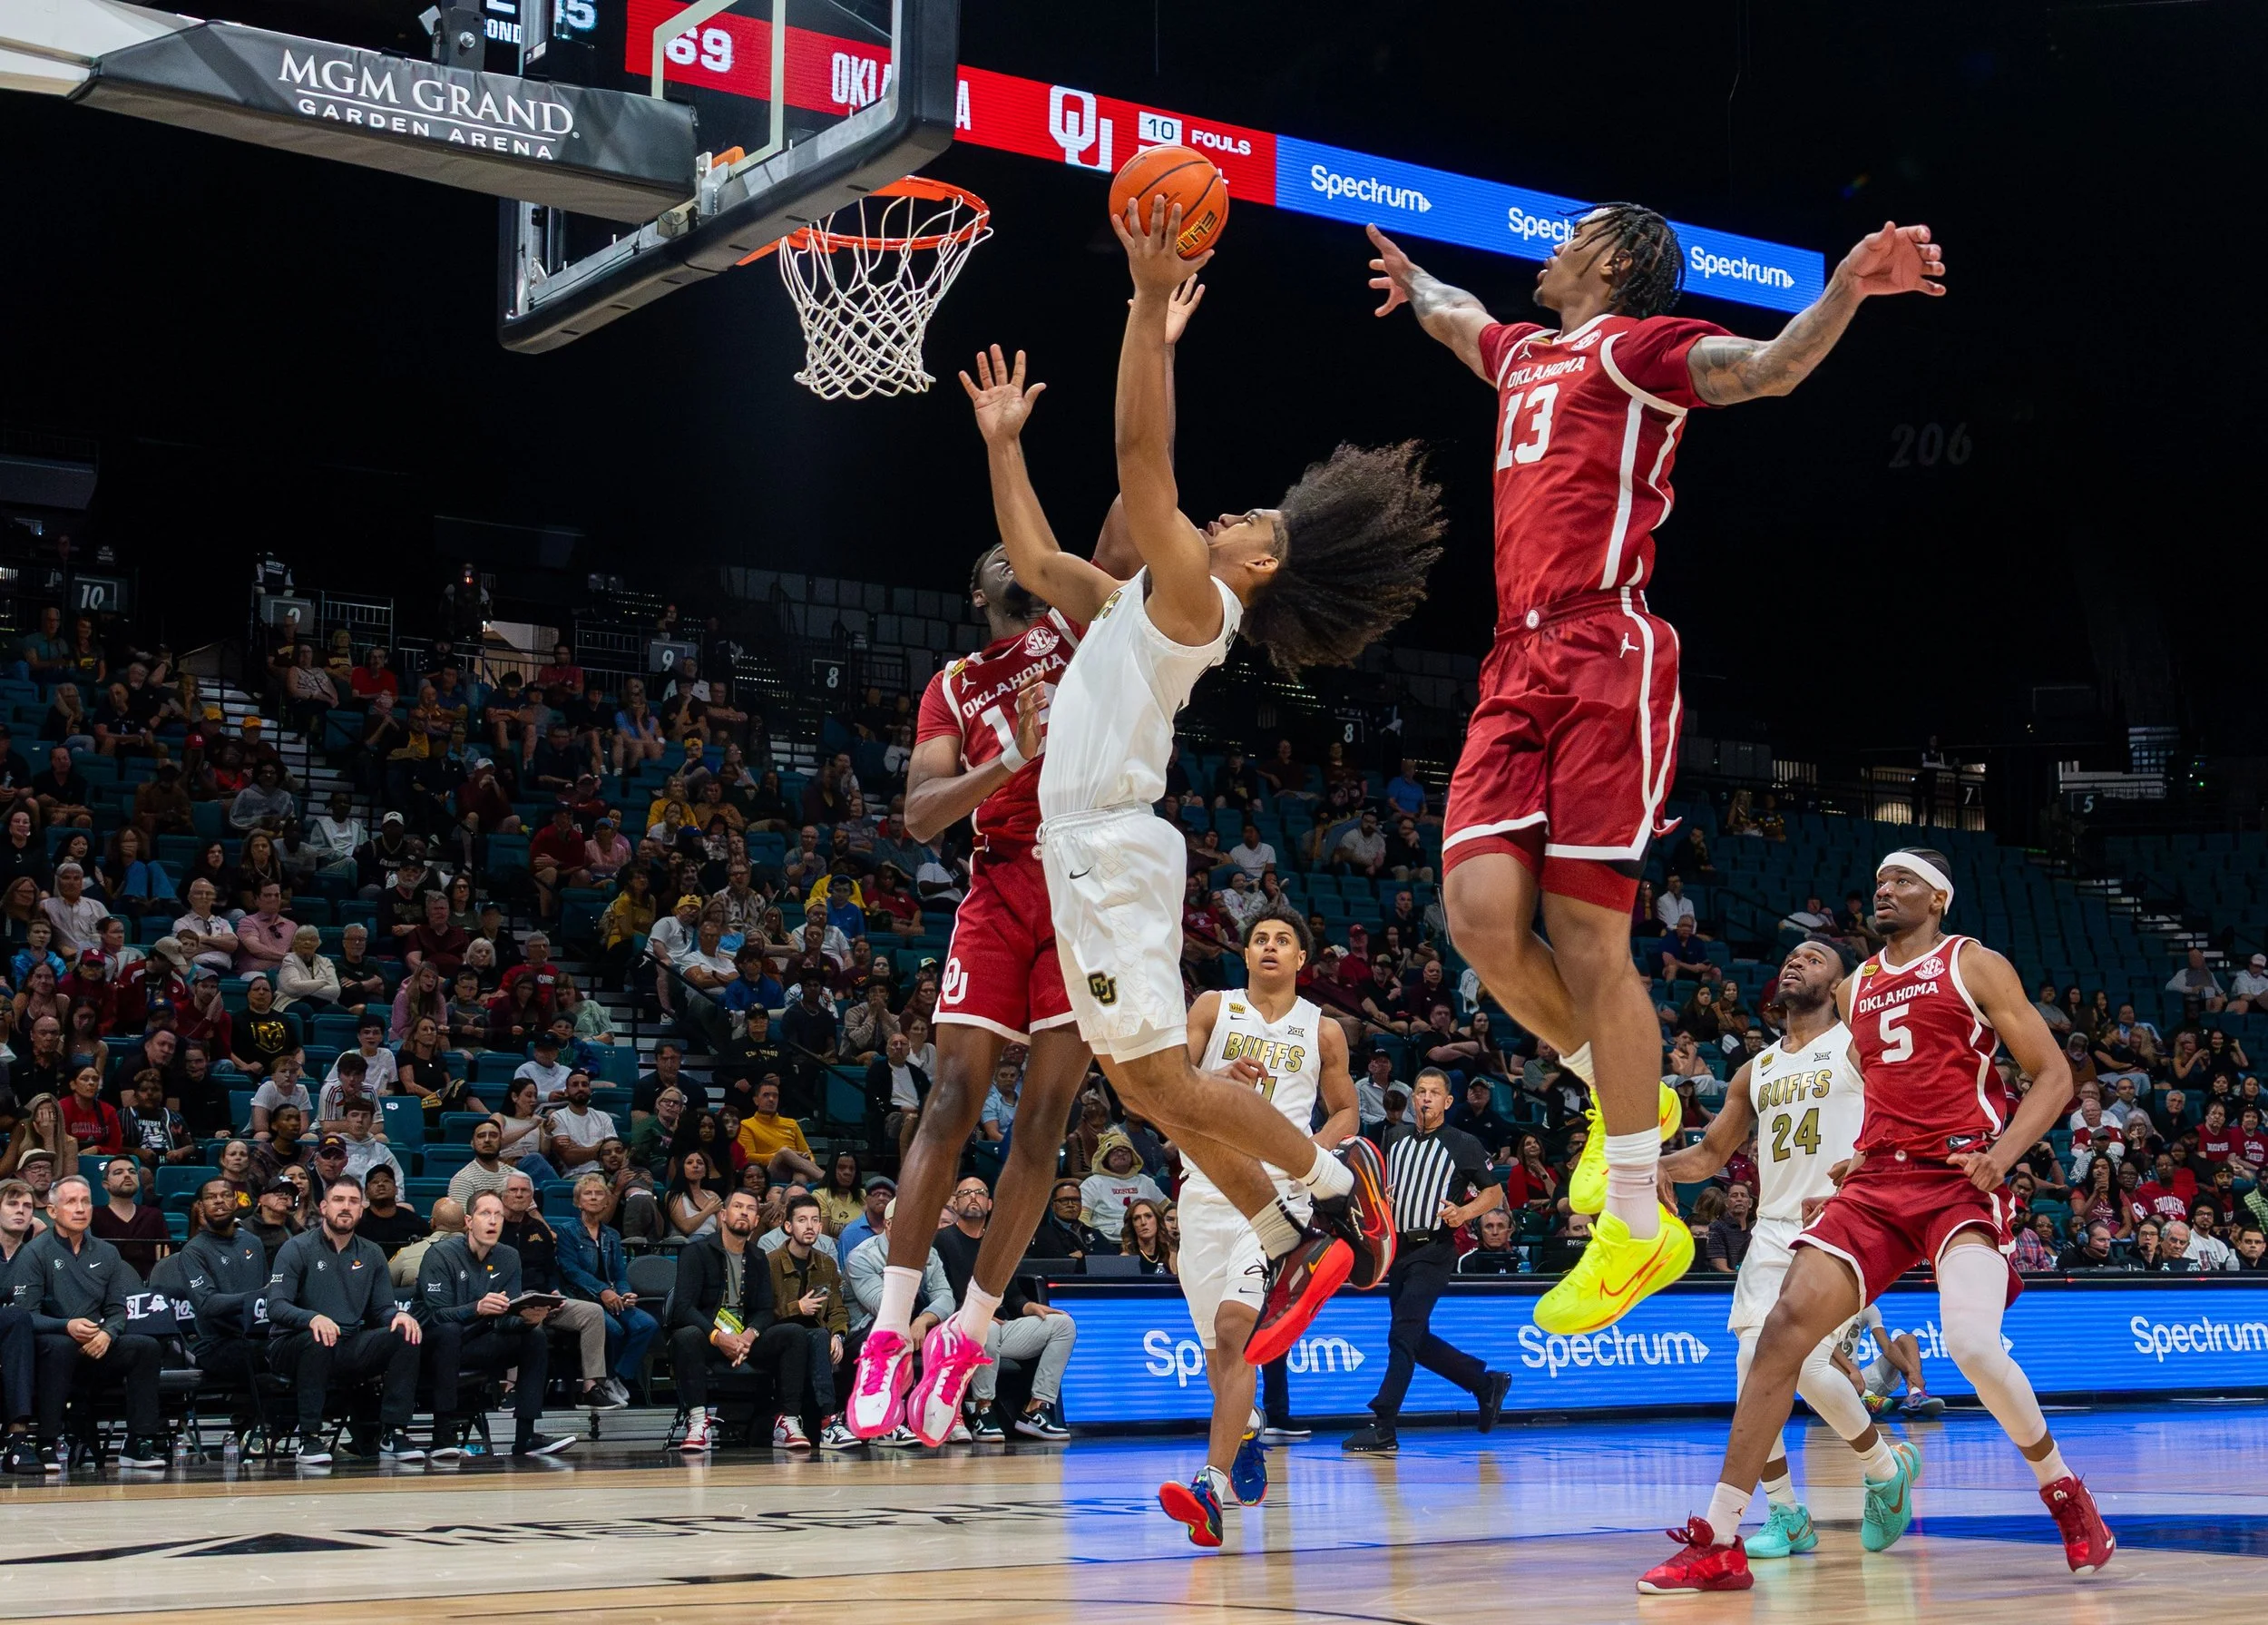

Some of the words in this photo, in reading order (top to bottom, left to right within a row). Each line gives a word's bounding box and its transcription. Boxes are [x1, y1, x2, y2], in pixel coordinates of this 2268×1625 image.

[664, 26, 733, 73] 69
[278, 49, 401, 104] MGM
[412, 79, 574, 134] GRAND
[298, 98, 430, 137] GARDEN
[448, 127, 553, 160] ARENA
[1149, 118, 1174, 141] 10
[1191, 130, 1252, 156] FOULS
[1311, 164, 1423, 211] Spectrum
[1508, 207, 1575, 241] Spect
[1691, 246, 1789, 288] Spectrum
[1507, 356, 1587, 389] OKLAHOMA
[1497, 383, 1559, 472] 13
[1888, 421, 1972, 469] 206
[81, 584, 103, 611] 10
[1028, 627, 1052, 651] SEC
[661, 650, 674, 672] 9
[826, 666, 839, 689] 8
[963, 653, 1067, 720] OKLAHOMA
[1343, 722, 1354, 744] 8
[1964, 787, 1973, 805] 7
[2083, 795, 2094, 814] 5
[1921, 958, 1944, 976] SEC
[1859, 981, 1940, 1013] OKLAHOMA
[1222, 1032, 1305, 1072] BUFFS
[1879, 1003, 1914, 1063] 5
[1758, 1069, 1833, 1113] BUFFS
[1772, 1107, 1822, 1162] 24
[2154, 1196, 2186, 1216] SOONERS
[1143, 1330, 1351, 1388] Spum
[1518, 1324, 1696, 1378] Spectrum
[2130, 1316, 2268, 1363] Spectrum
